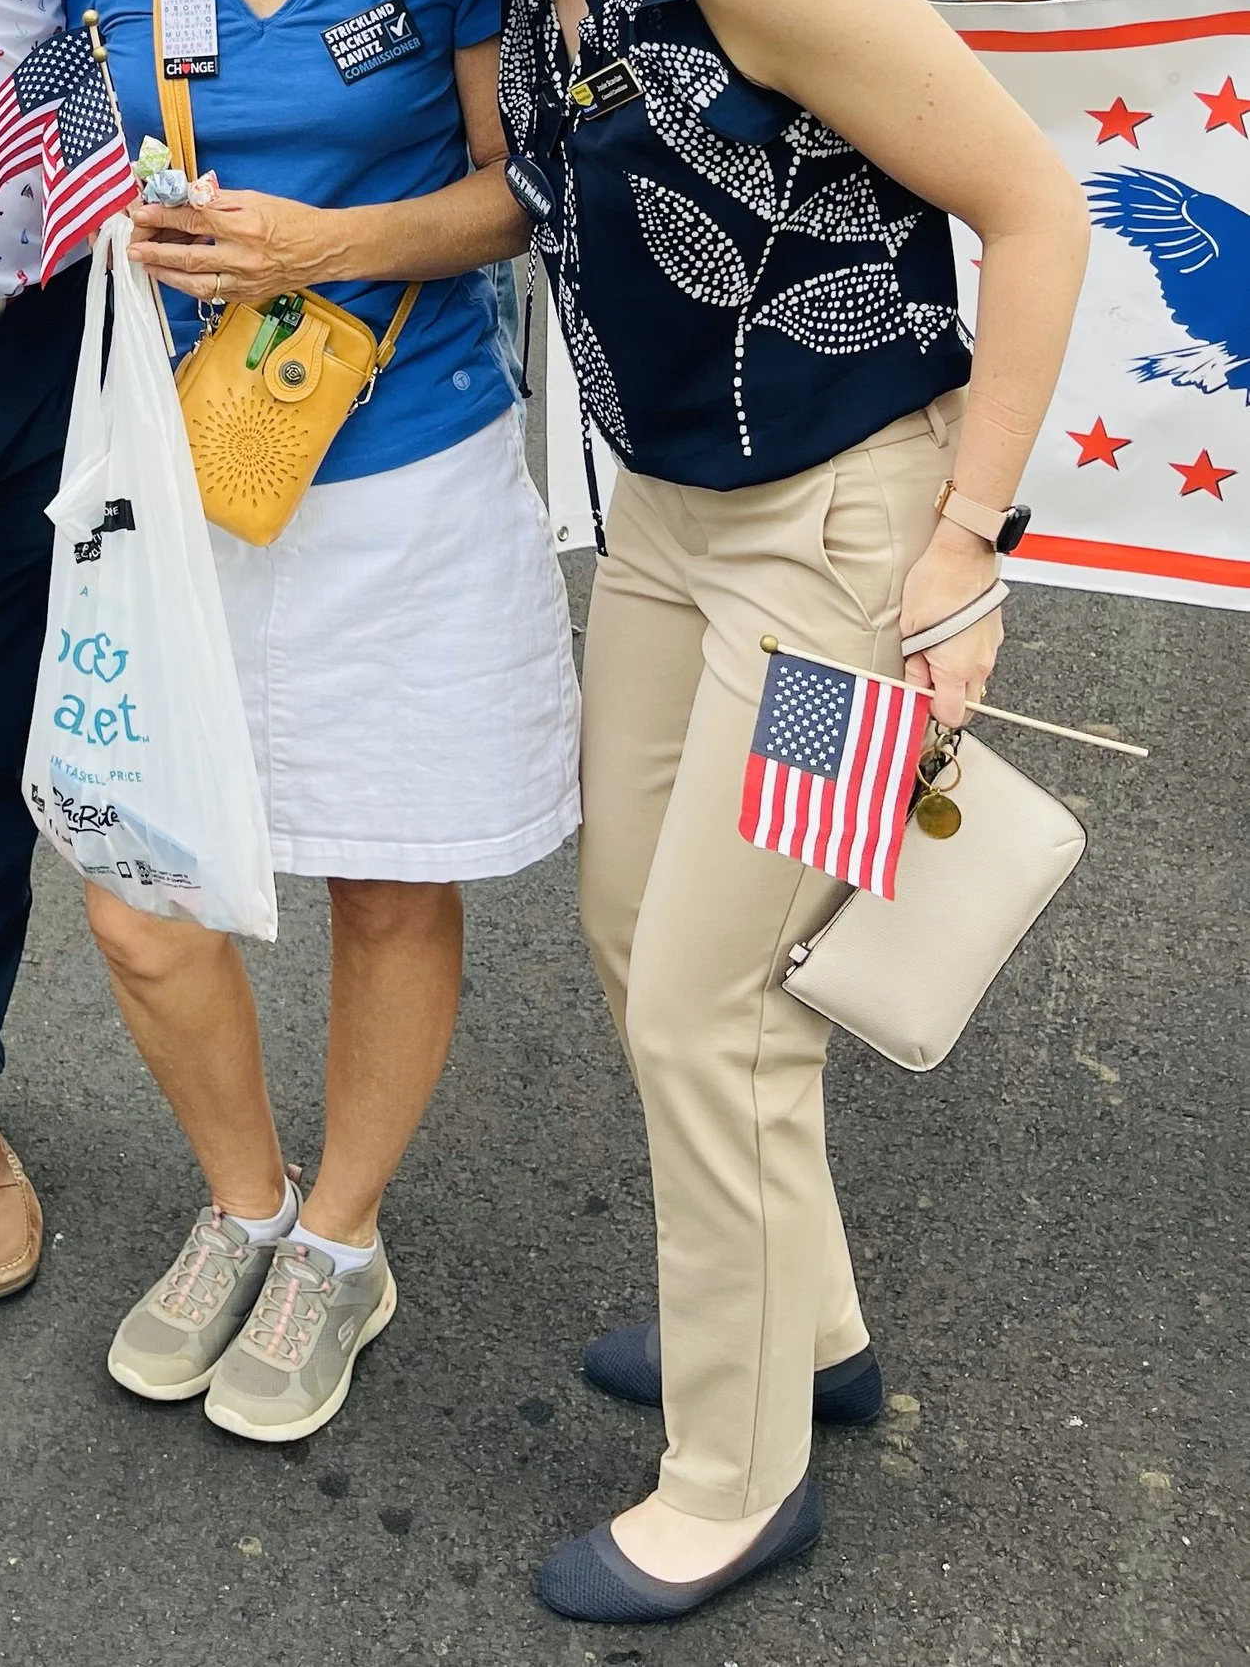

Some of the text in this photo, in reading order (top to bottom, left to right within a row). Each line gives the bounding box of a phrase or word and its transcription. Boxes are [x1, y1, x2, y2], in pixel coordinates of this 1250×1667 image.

[324, 3, 395, 44] STRICKLAND
[331, 23, 383, 57] SACKETT
[166, 61, 215, 75] CHNGE
[337, 40, 383, 70] RAVITZ
[345, 37, 421, 79] COMMISSIONER
[508, 165, 551, 215] ALTMAN
[110, 770, 142, 783] PRICE
